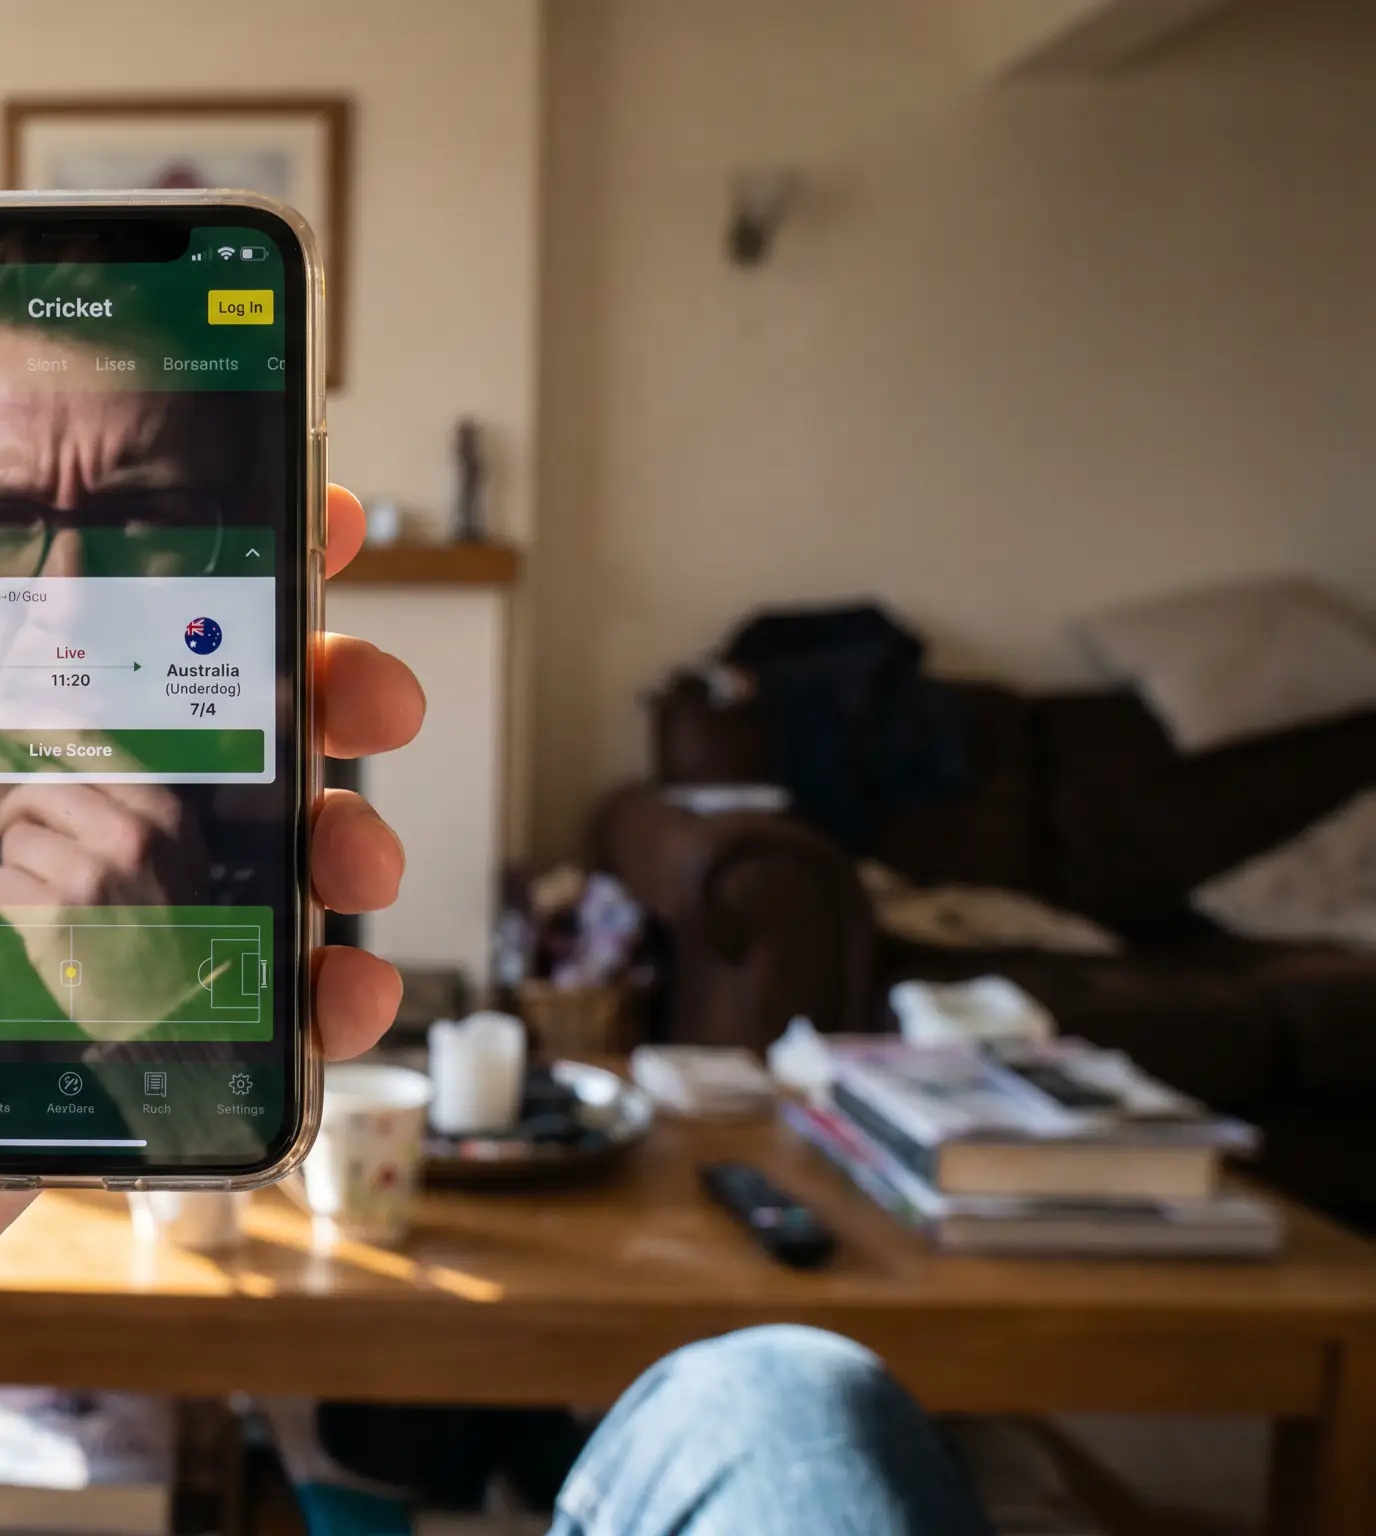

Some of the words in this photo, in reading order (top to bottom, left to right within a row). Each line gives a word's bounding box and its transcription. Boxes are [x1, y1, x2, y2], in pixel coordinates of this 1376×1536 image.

[28, 298, 112, 318] Cricket
[218, 301, 245, 316] Log
[249, 302, 263, 313] In
[96, 358, 135, 371] Lises
[56, 647, 85, 659] Live
[167, 663, 240, 677] Australia
[52, 674, 90, 686] 11:20
[165, 683, 241, 697] (Underdog)
[190, 702, 216, 717] 7/4
[29, 743, 62, 757] Live
[66, 743, 112, 757] Score
[143, 1103, 171, 1115] Ruch
